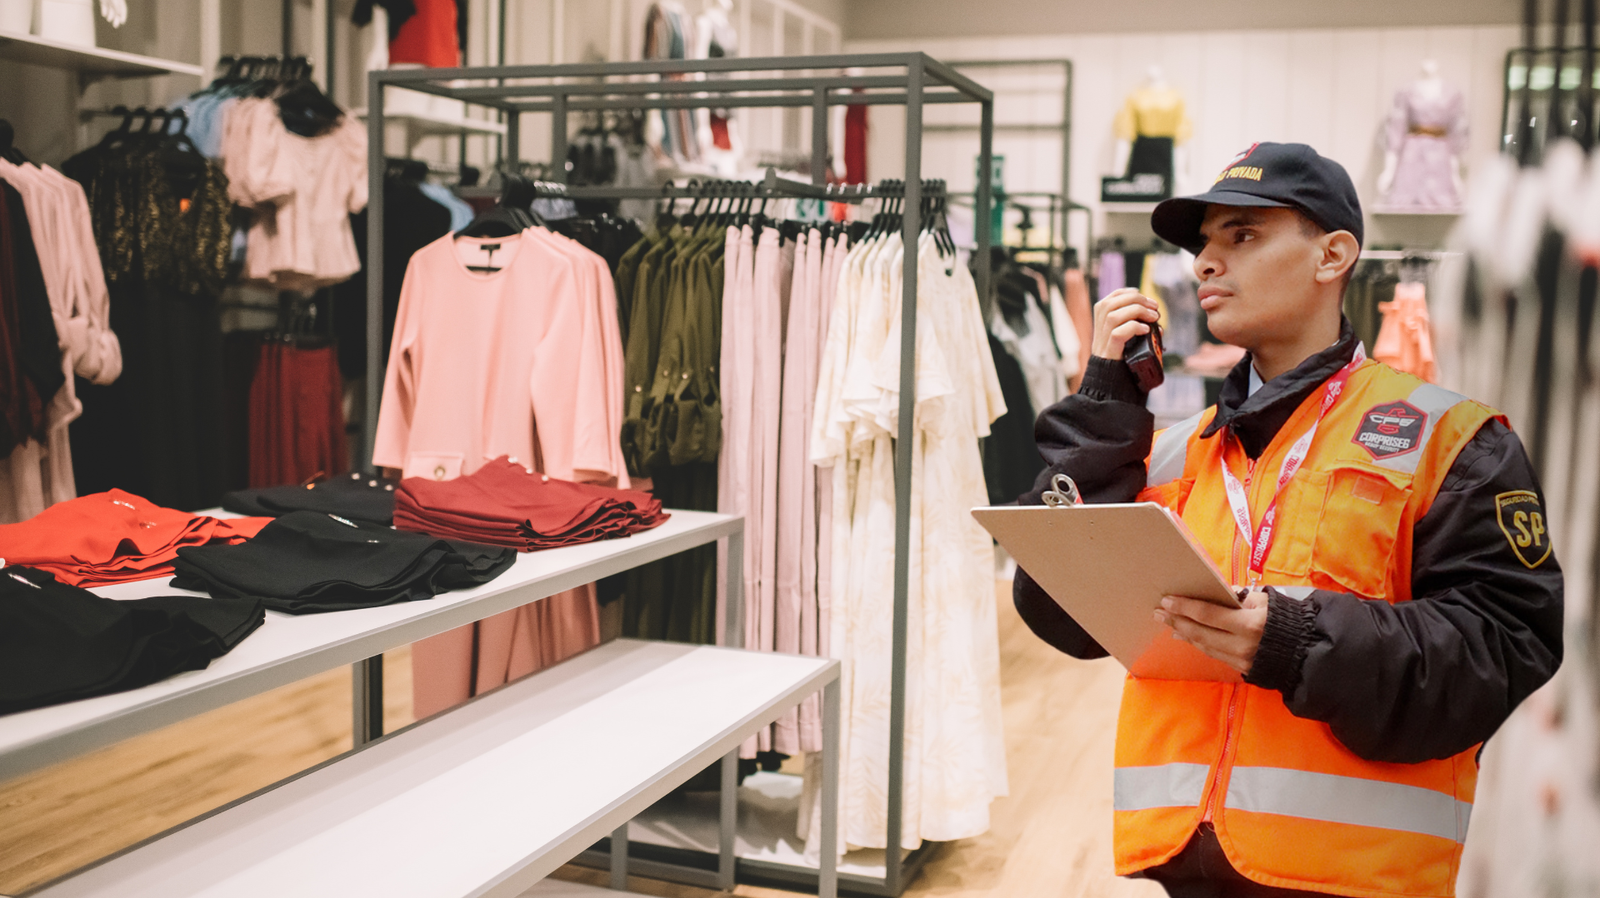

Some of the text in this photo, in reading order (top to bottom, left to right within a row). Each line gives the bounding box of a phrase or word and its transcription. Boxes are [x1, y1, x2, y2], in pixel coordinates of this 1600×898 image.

[1226, 166, 1263, 181] PRIVADA
[1359, 432, 1411, 449] CORPRISEG
[1513, 510, 1545, 548] SP
[1252, 526, 1272, 567] CORPRISEG
